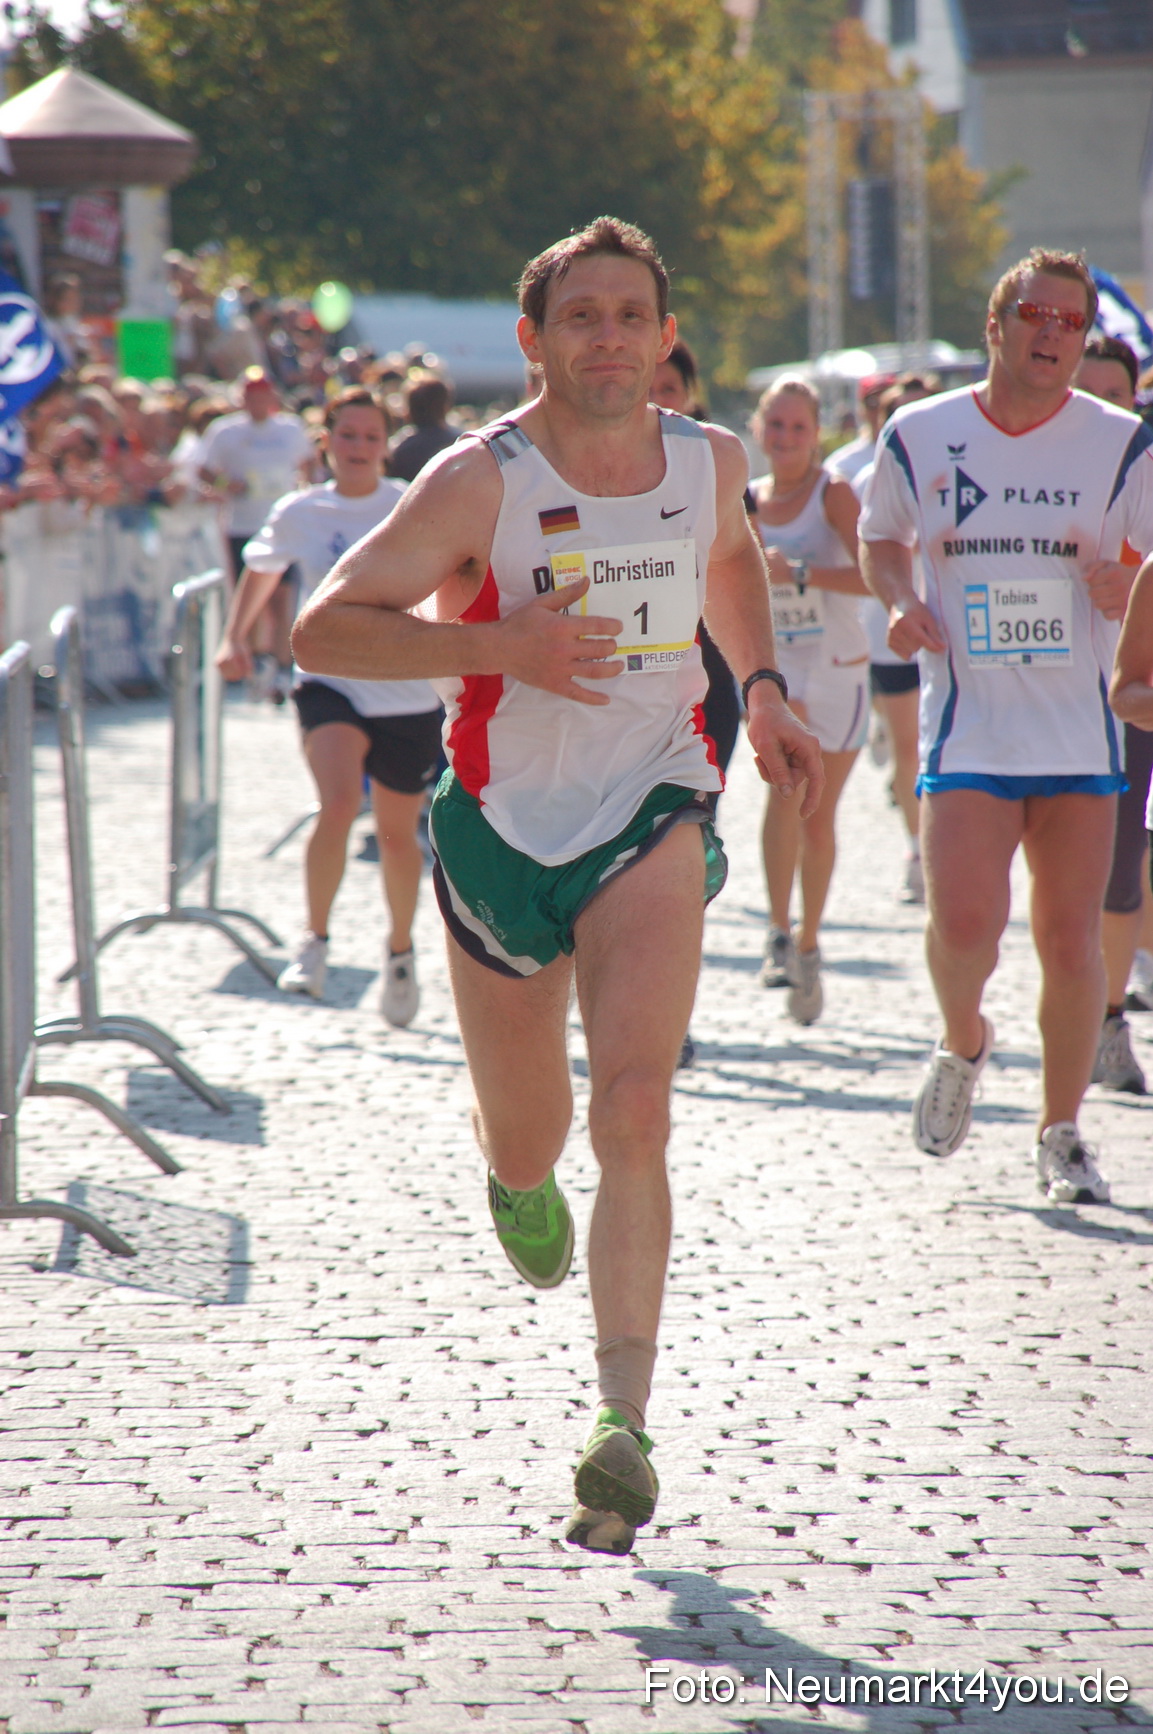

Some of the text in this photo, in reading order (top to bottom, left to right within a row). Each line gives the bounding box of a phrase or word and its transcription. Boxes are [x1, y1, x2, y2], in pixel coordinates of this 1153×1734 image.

[1004, 487, 1081, 507] PLAST
[943, 538, 1079, 558] RUNNING TEAM
[593, 557, 675, 584] Christian
[994, 589, 1038, 606] Tobias
[633, 602, 648, 635] 1
[998, 618, 1064, 643] 3066
